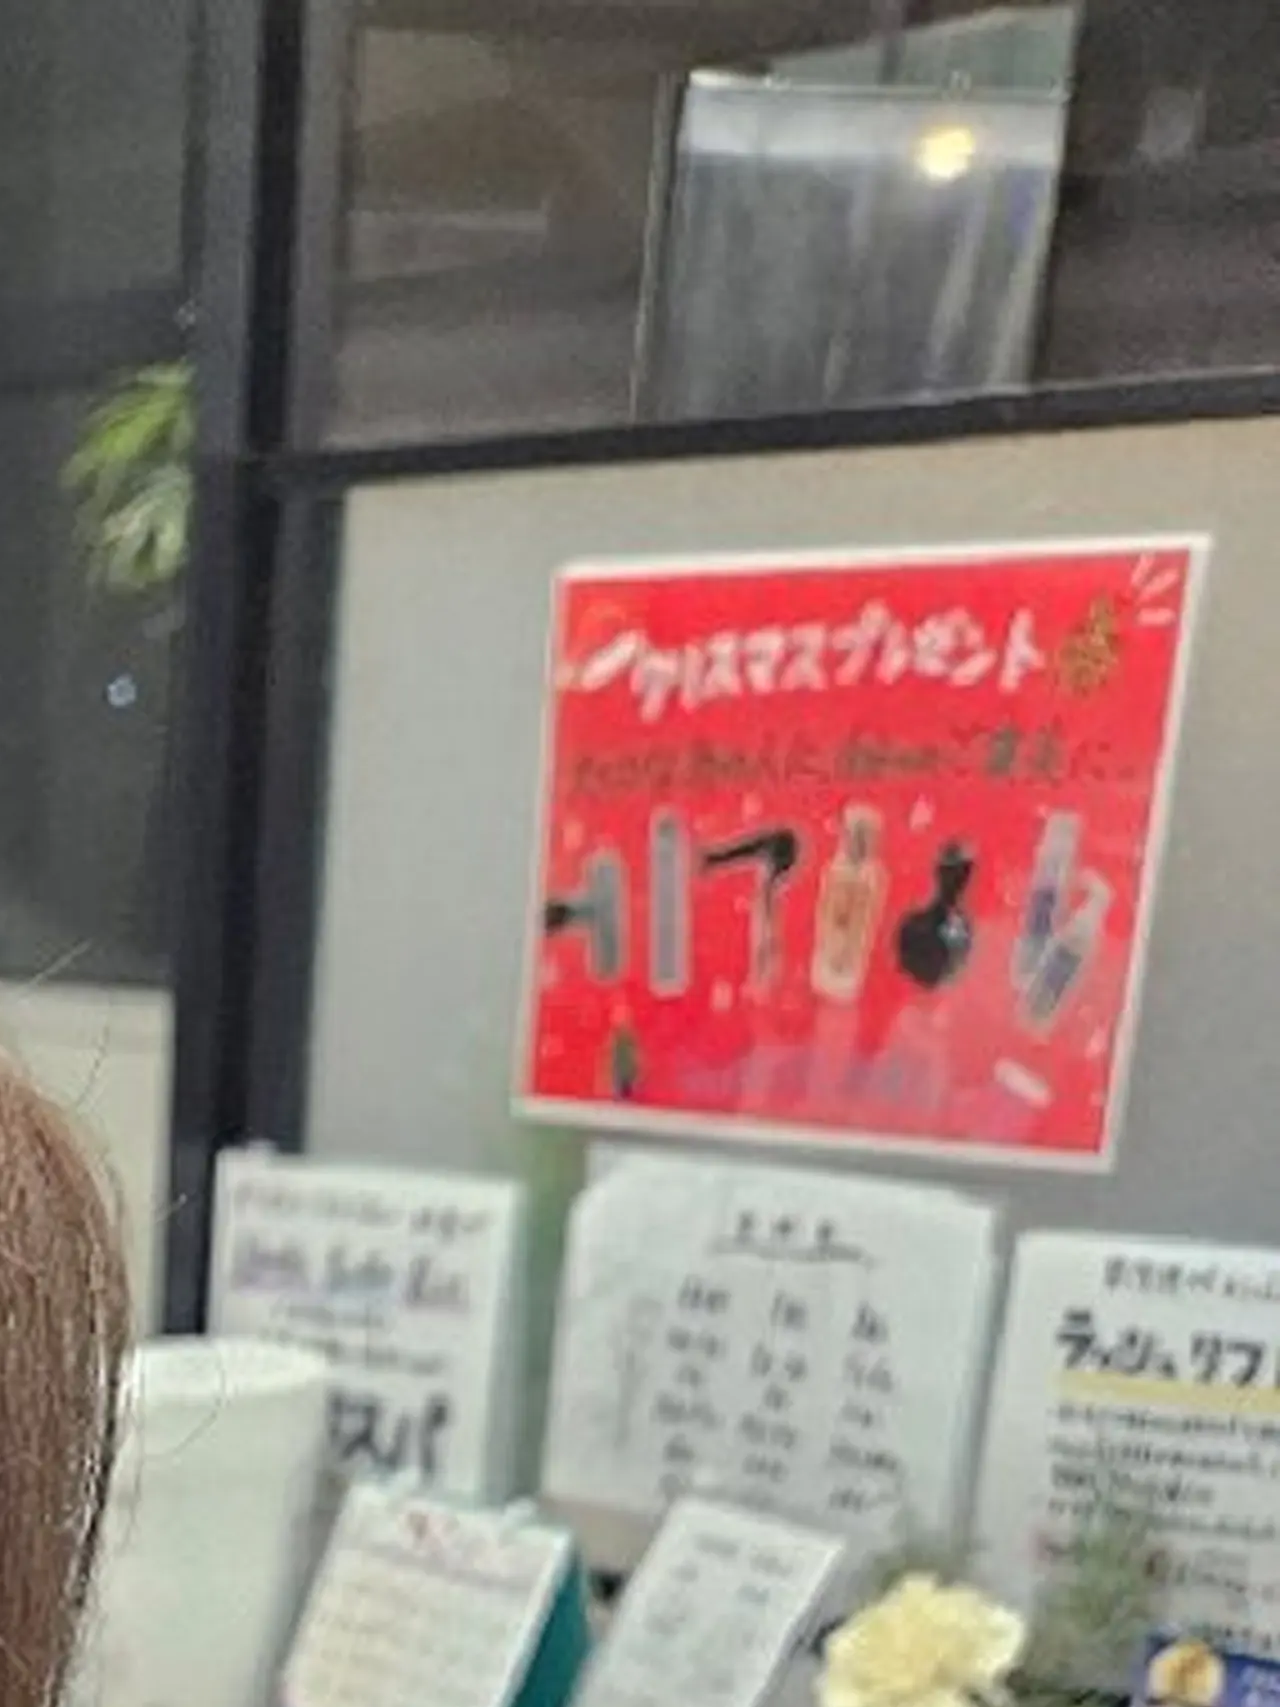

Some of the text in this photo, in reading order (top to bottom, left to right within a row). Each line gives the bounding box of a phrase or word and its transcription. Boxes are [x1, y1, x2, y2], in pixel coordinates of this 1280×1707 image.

[1056, 1308, 1280, 1389] ラッシュリフ
